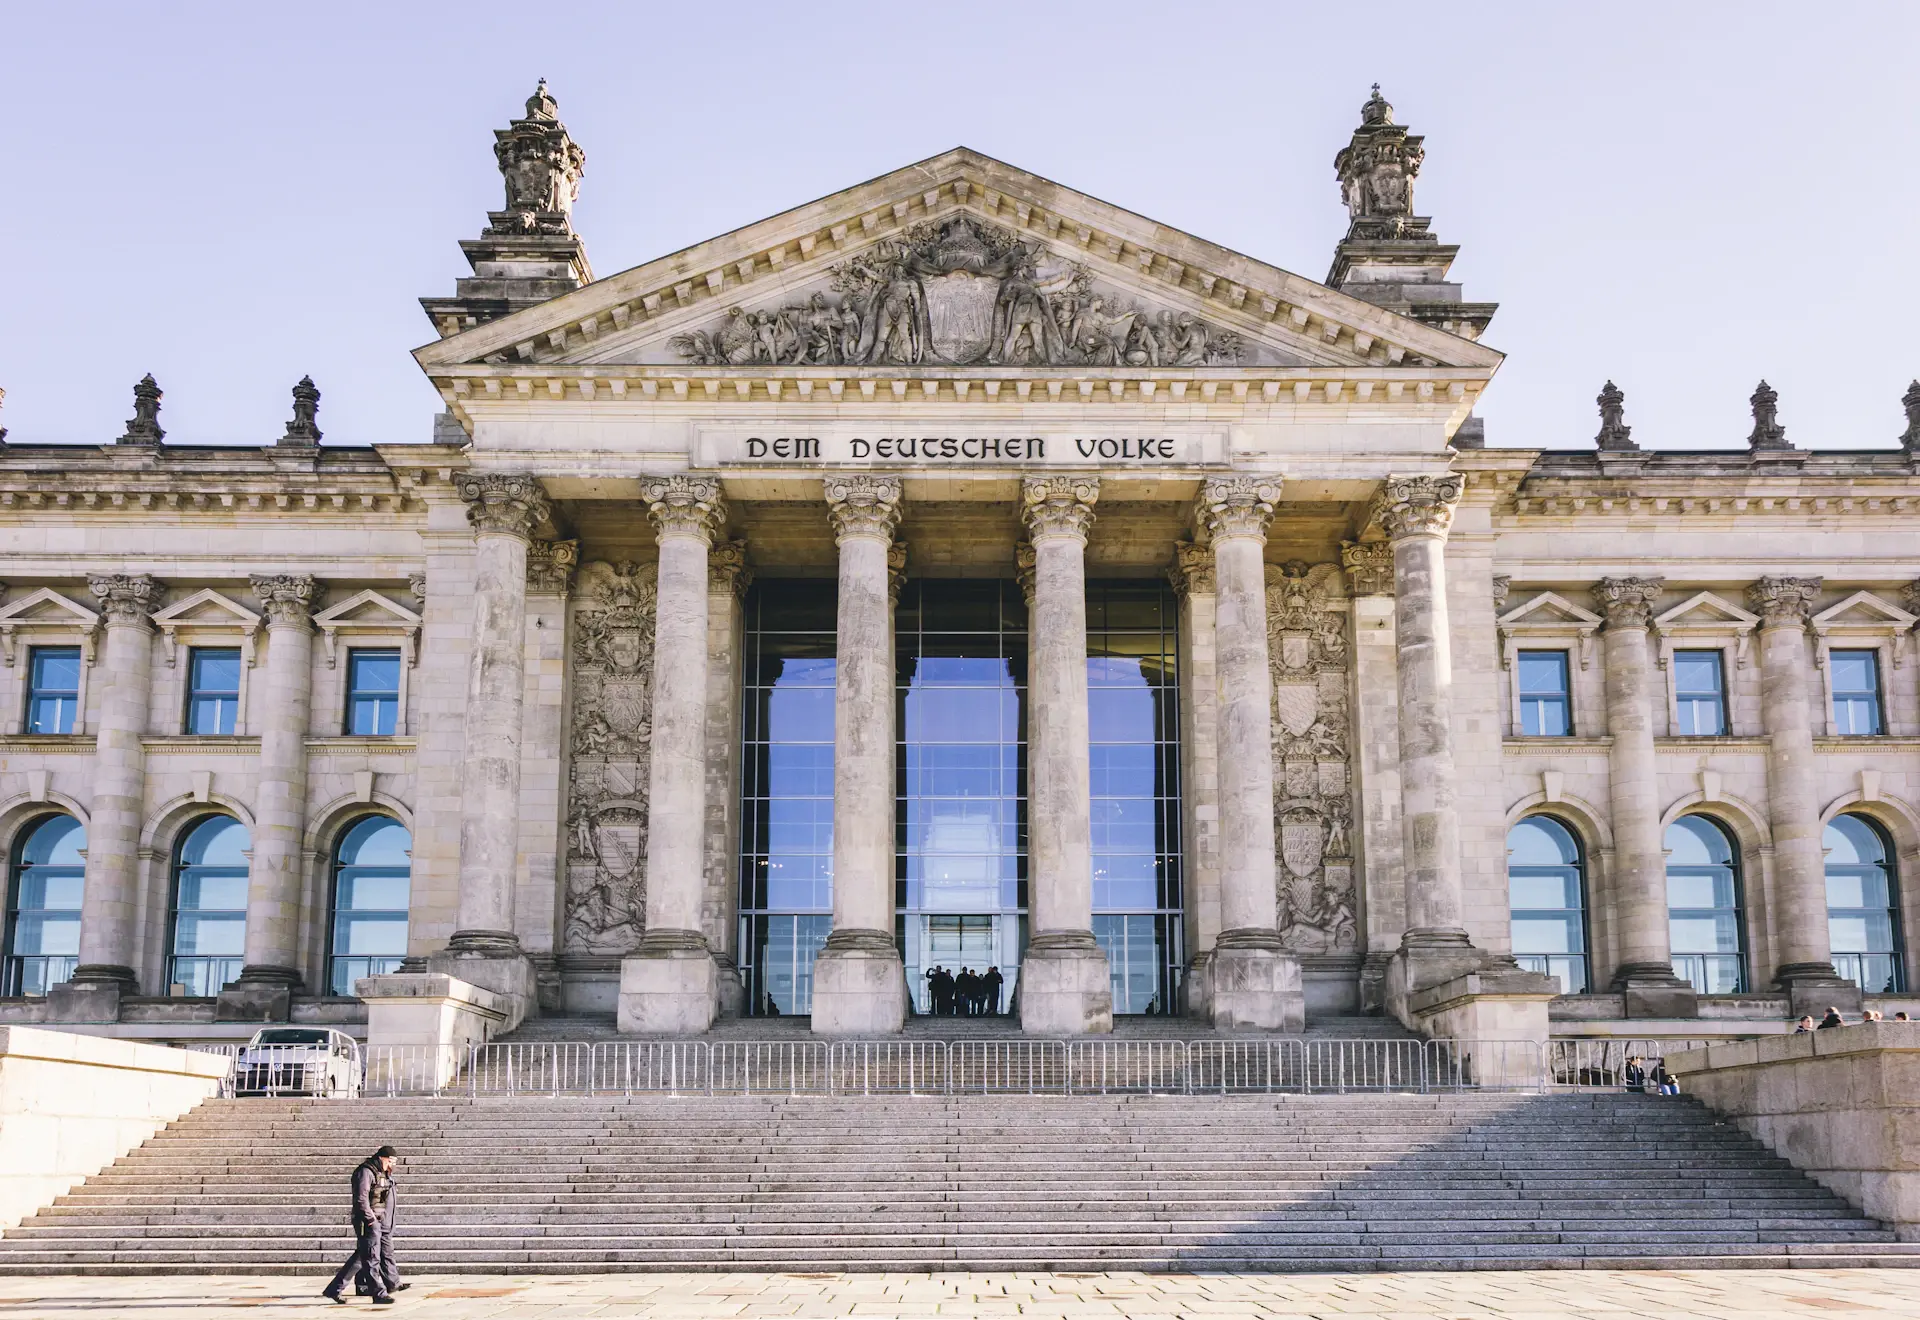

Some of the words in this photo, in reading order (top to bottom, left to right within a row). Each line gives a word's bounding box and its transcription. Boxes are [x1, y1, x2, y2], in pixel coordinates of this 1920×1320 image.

[746, 437, 821, 459] DEM
[849, 438, 1046, 460] DEUTSCHEN
[1074, 438, 1175, 460] VOLKE
